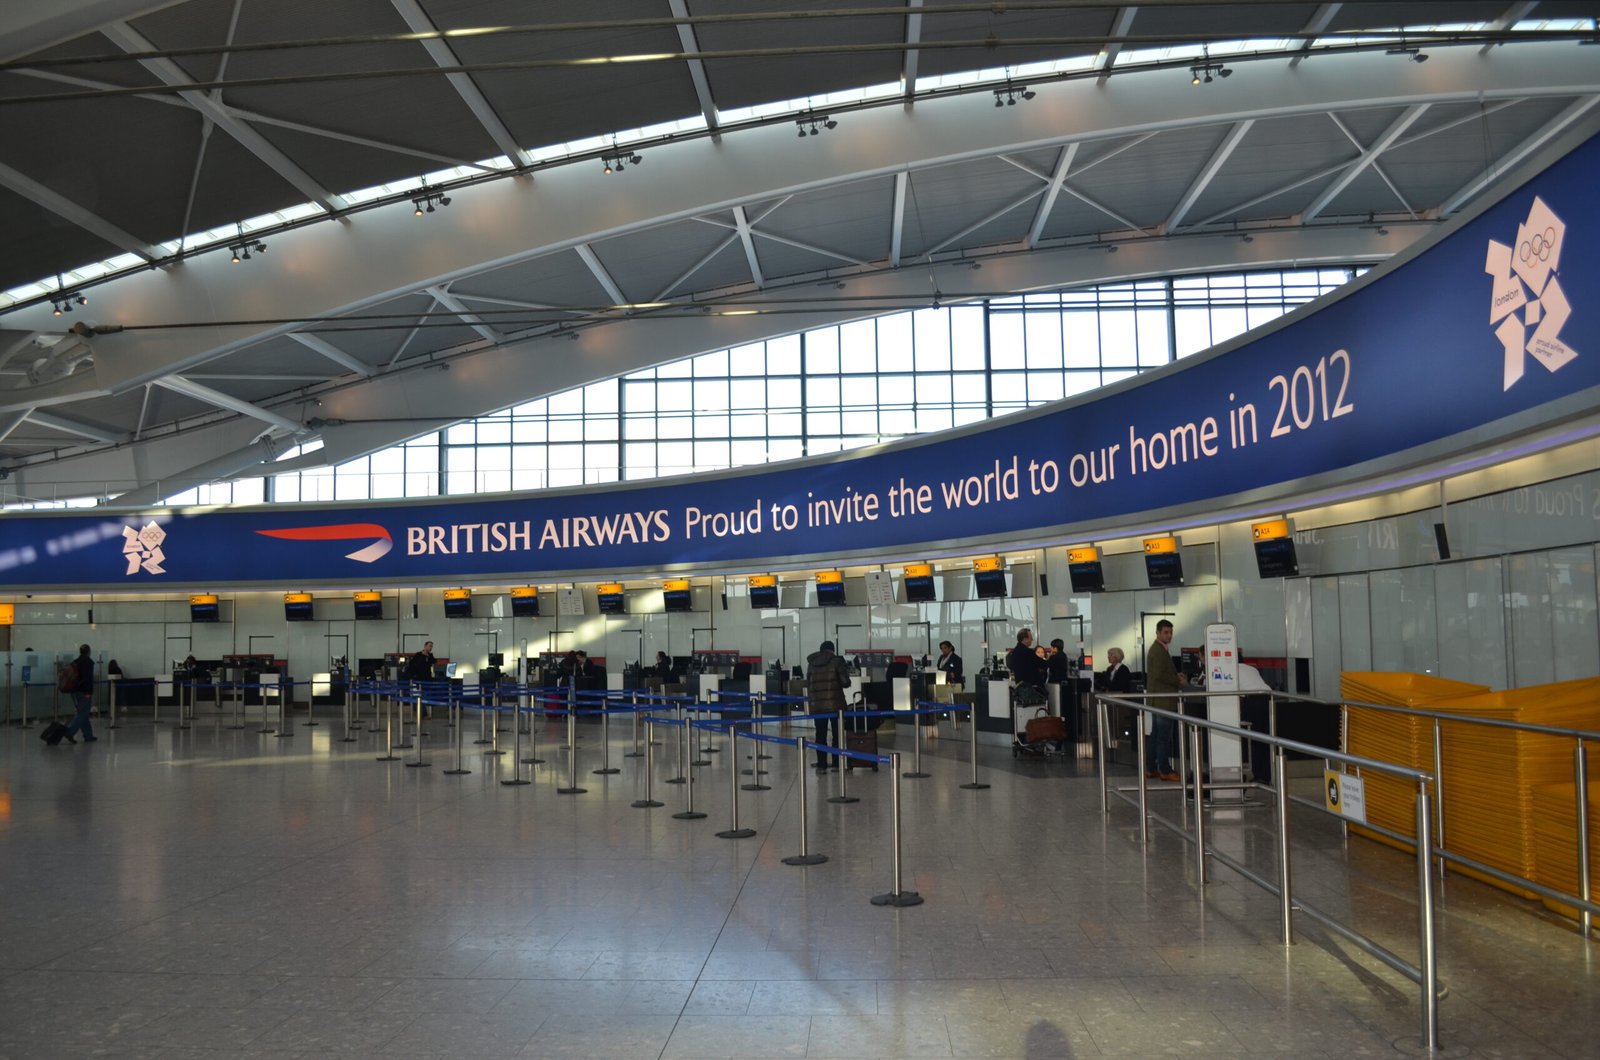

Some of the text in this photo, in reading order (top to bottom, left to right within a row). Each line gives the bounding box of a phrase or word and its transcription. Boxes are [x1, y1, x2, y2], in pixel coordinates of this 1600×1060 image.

[1494, 289, 1519, 308] london
[408, 350, 1353, 555] BRITISH AIRWAYS Proud to invite the world to our home in 2012
